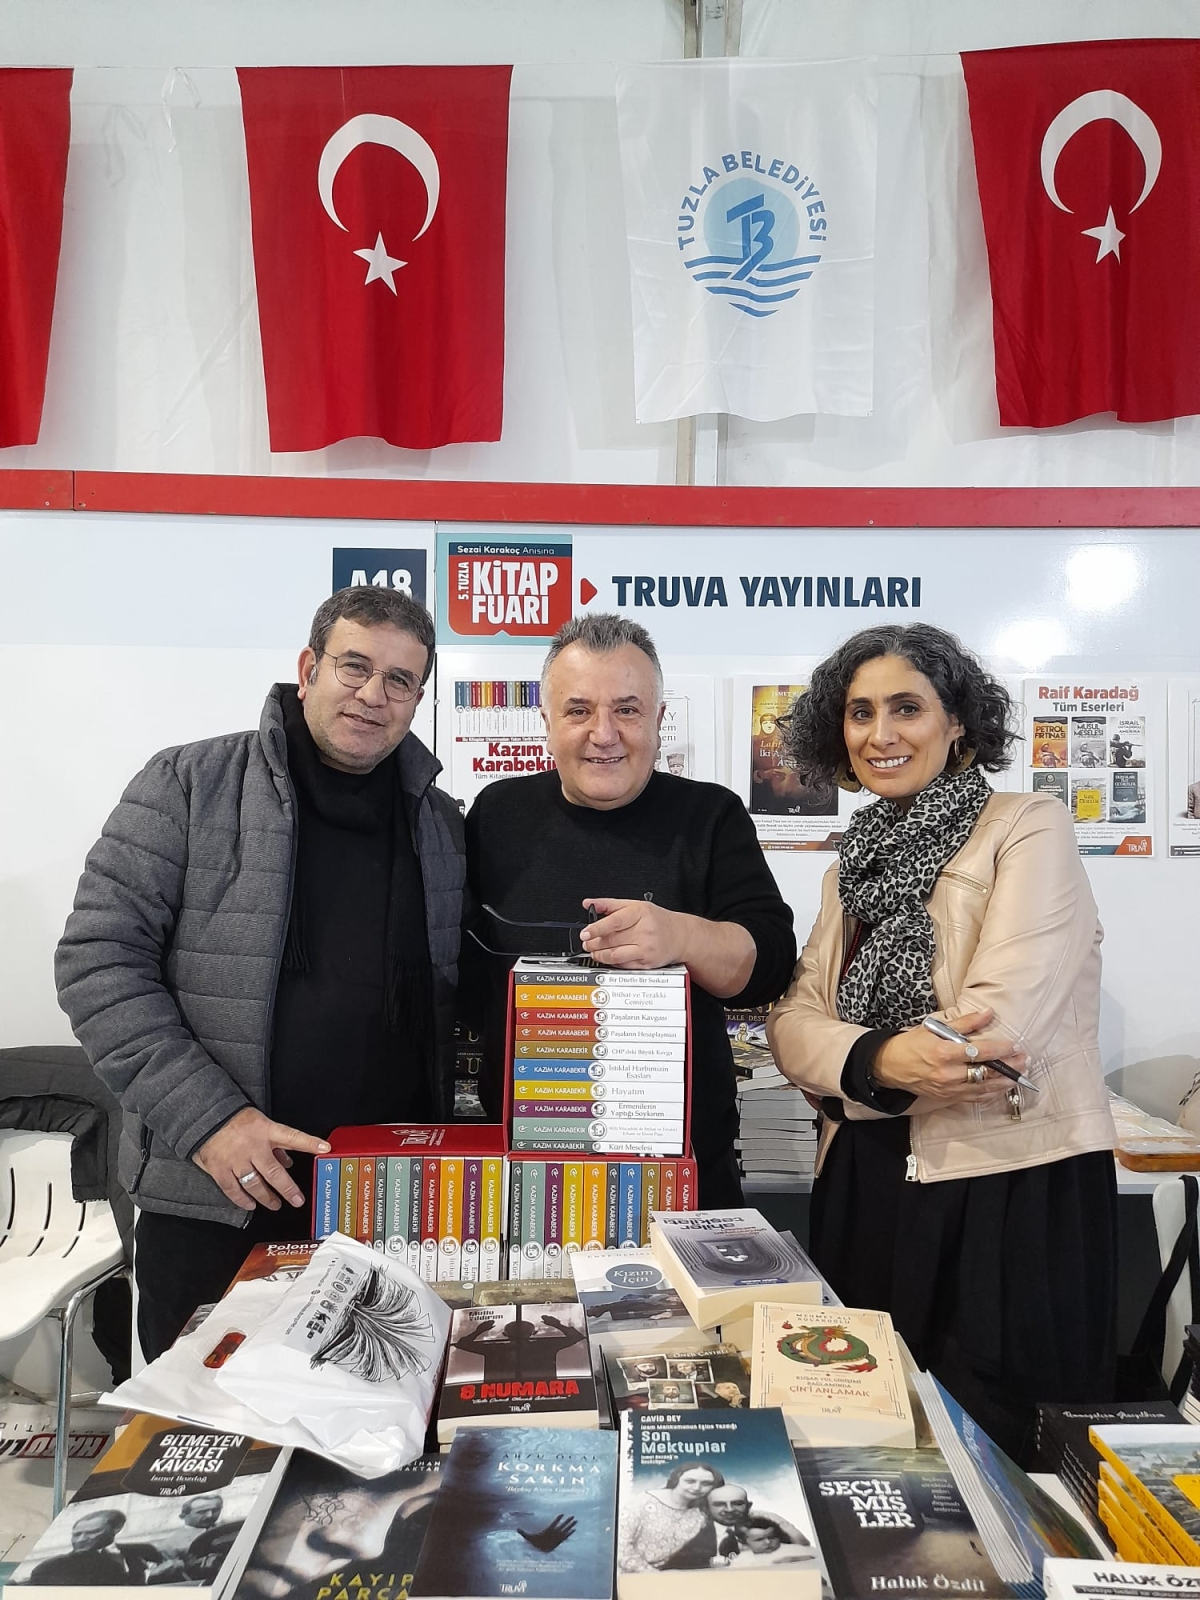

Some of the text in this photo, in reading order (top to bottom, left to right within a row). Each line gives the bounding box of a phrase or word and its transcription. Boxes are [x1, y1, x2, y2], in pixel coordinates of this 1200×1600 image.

[678, 166, 720, 251] TUZLA
[457, 546, 554, 555] Sezai Karakoç Anısına
[473, 560, 558, 595] KİTAP
[612, 576, 921, 608] TRUVA YAYINLARI
[472, 595, 548, 624] FUARI
[1039, 686, 1139, 701] Raif Karadağ
[1053, 702, 1124, 712] Tüm Eserleri
[489, 743, 543, 756] Kazım
[611, 1014, 640, 1022] Paşaların
[612, 1088, 645, 1096] Hayatım
[611, 1110, 633, 1118] Yaptığı
[614, 1269, 653, 1277] Kızım
[623, 1276, 648, 1284] İçin
[461, 1380, 579, 1399] 8 NUMARA
[815, 1387, 870, 1397] ANLAMAK
[160, 1435, 245, 1447] BİTMEYEN
[642, 1431, 670, 1441] Son
[163, 1447, 227, 1459] DEVLET
[642, 1441, 727, 1456] Mektuplar
[149, 1459, 223, 1472] KAVGASI
[498, 1462, 600, 1473] KORKMA
[510, 1474, 585, 1485] SAKIN
[856, 1512, 915, 1528] LER
[330, 1574, 414, 1586] KAYIP
[871, 1574, 987, 1592] Haluk Özdil
[1094, 1572, 1161, 1586] HALUK
